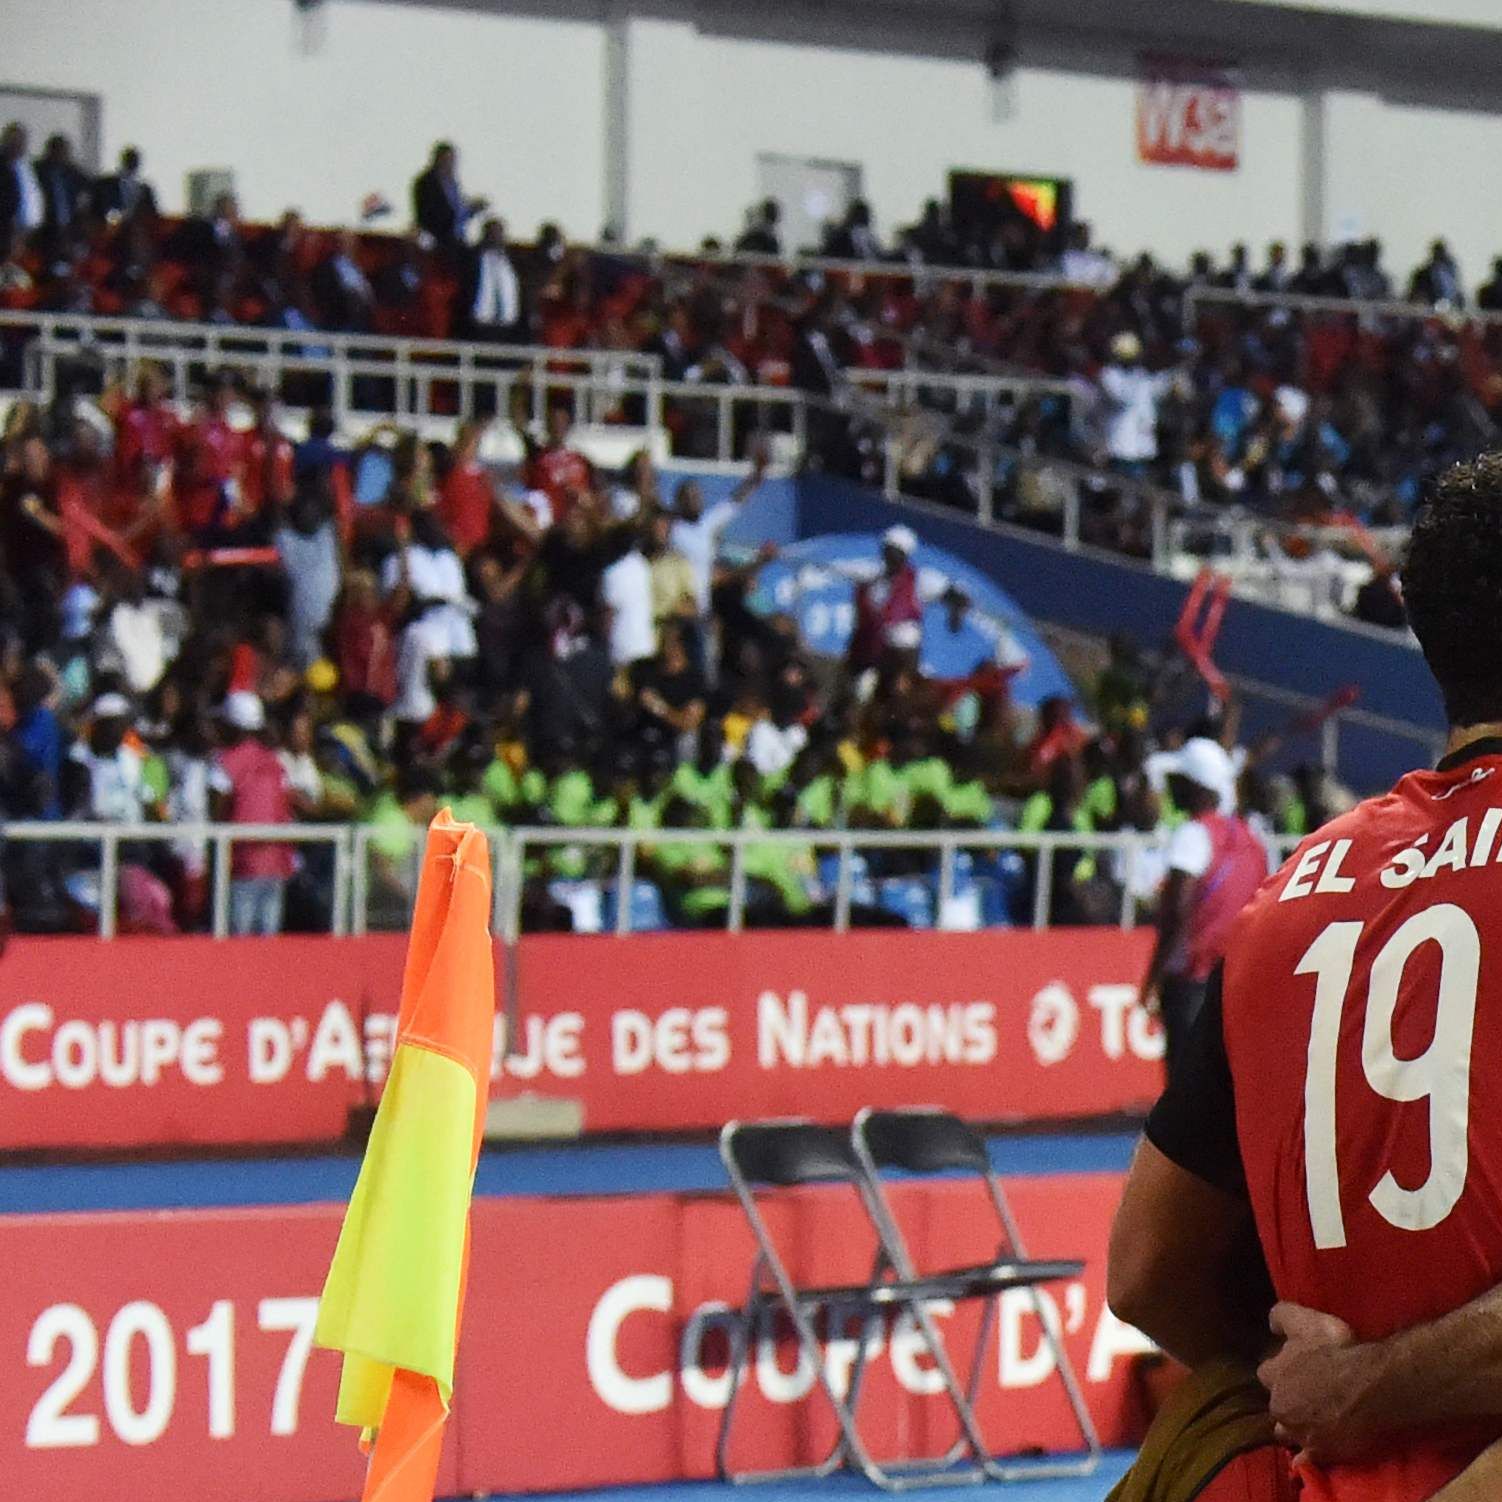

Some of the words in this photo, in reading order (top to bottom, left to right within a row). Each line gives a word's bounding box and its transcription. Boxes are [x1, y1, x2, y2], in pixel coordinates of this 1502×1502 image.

[1279, 838, 1357, 902] EL
[1293, 902, 1481, 1251] 19
[25, 1297, 322, 1447] 2017
